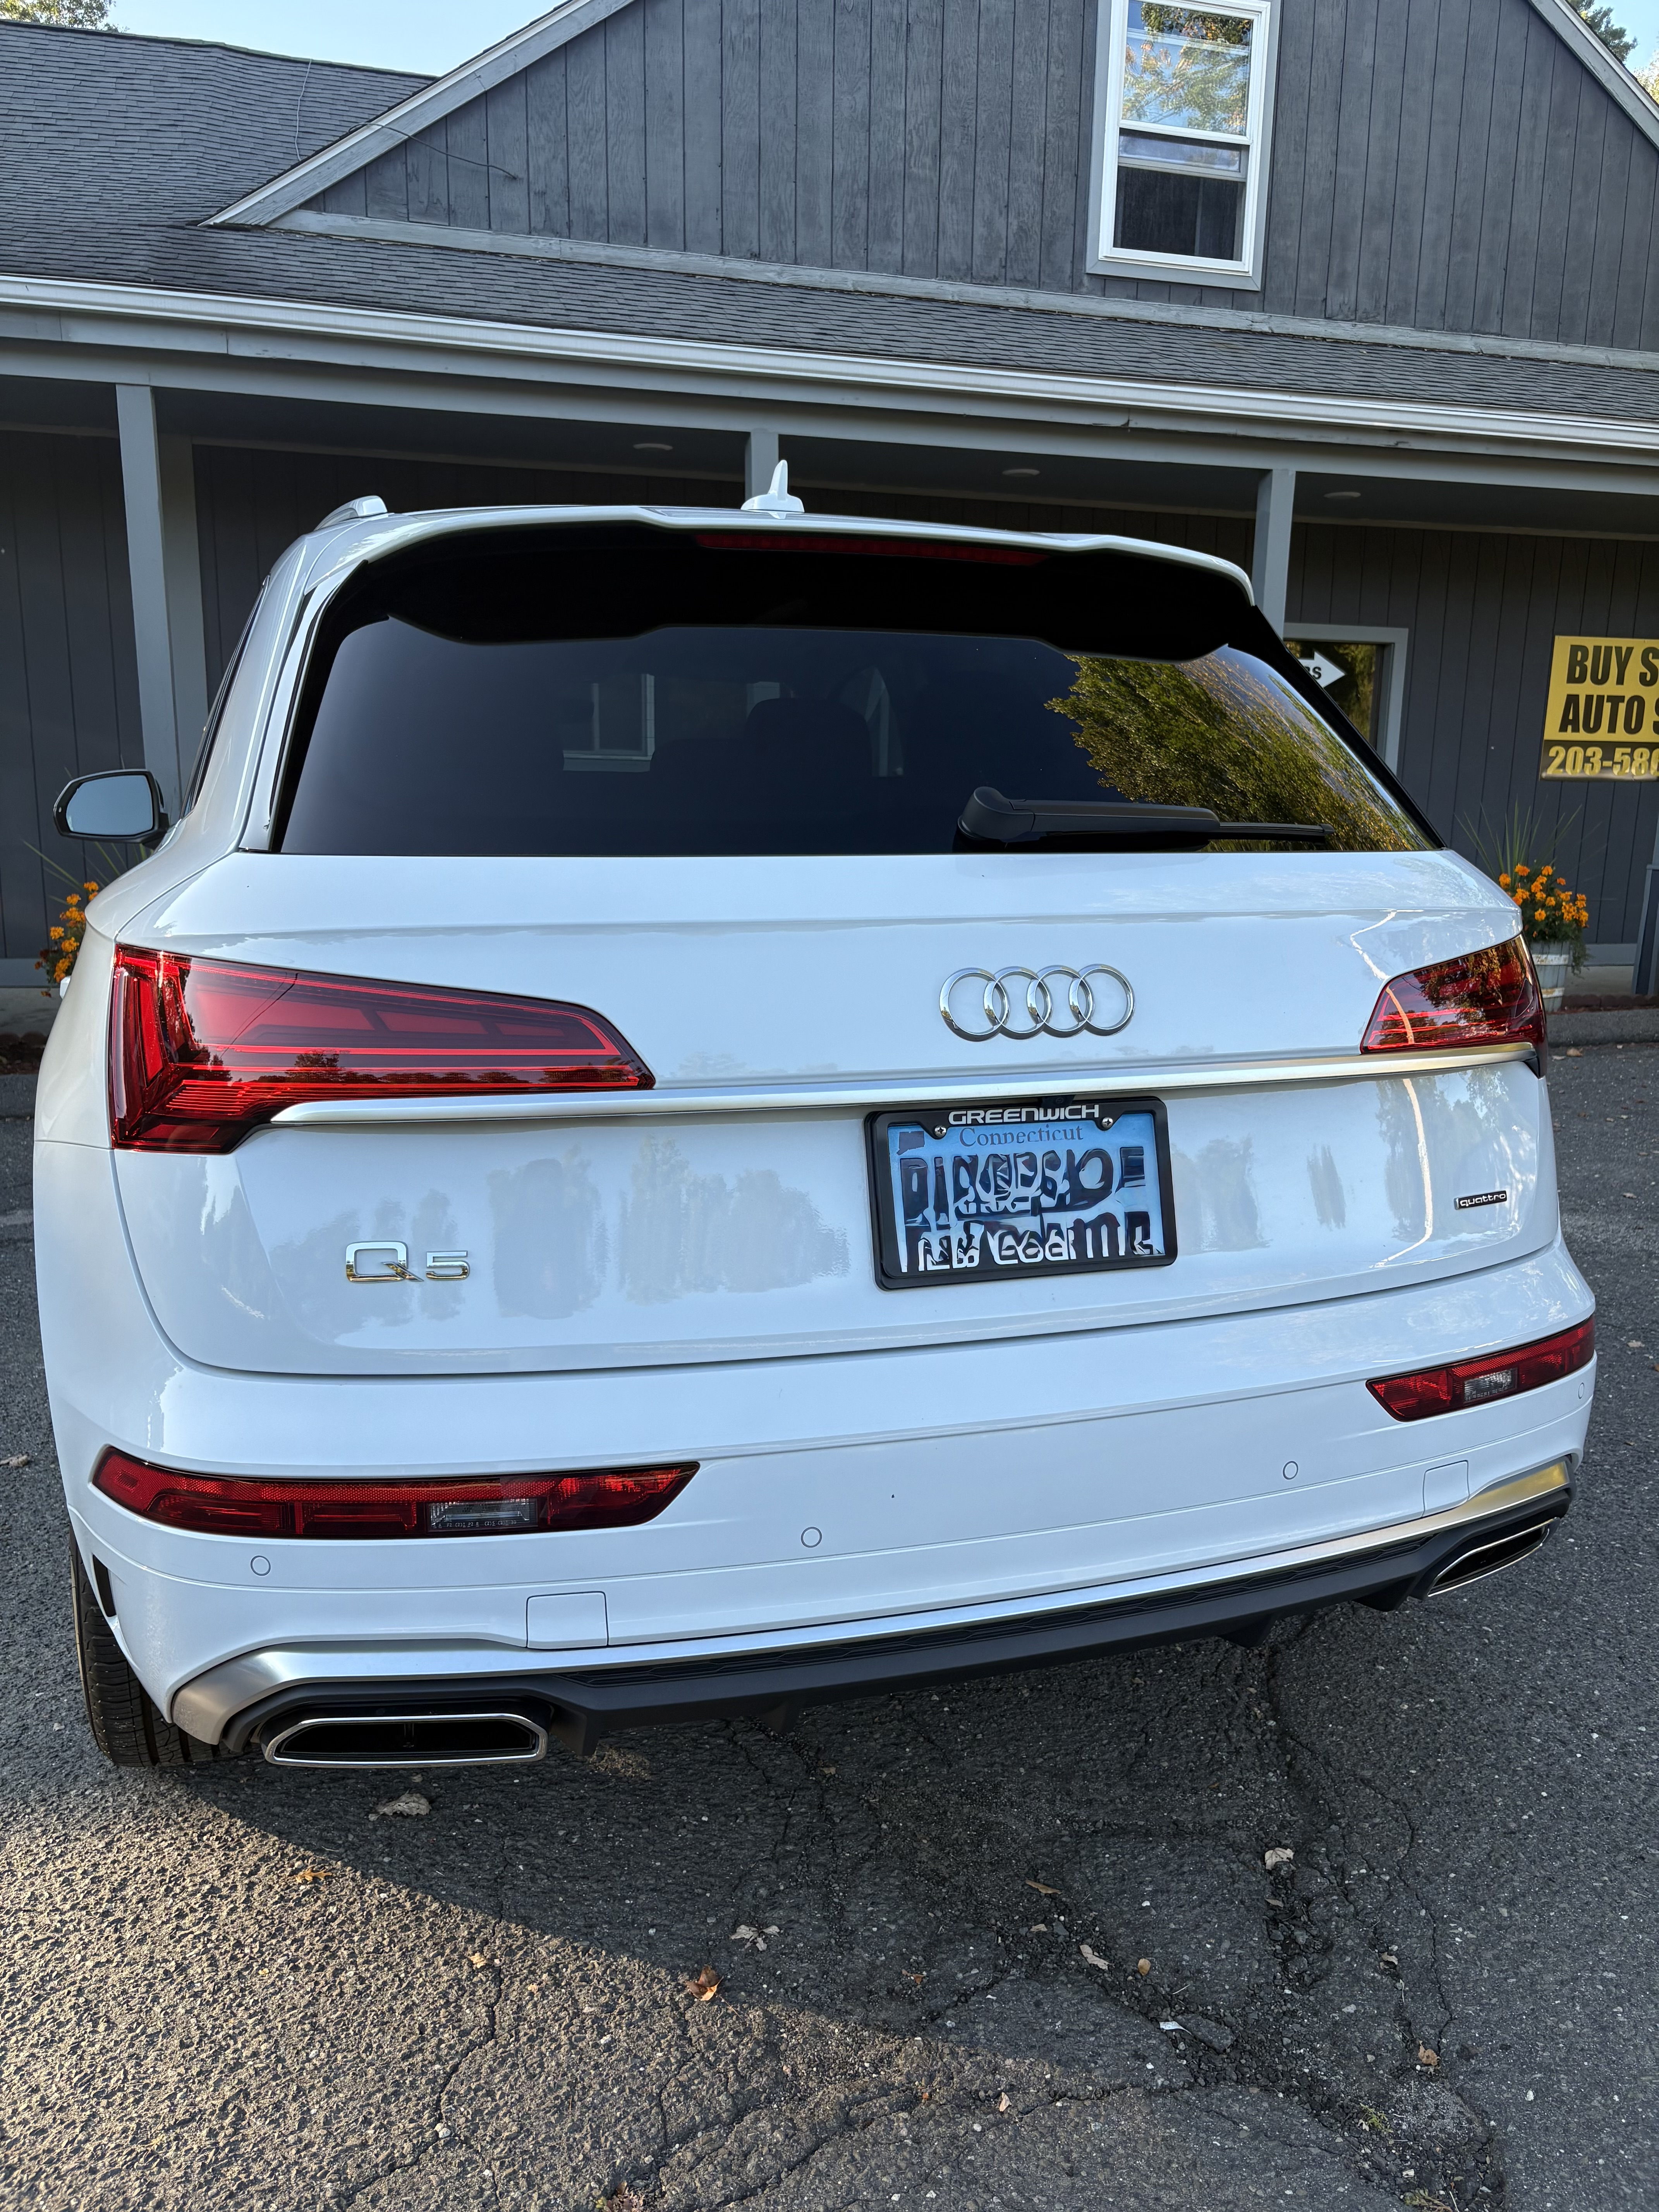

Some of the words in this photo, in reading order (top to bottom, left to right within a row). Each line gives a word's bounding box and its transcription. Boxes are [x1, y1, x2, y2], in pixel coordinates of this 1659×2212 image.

[1566, 645, 1634, 685] BUY
[1559, 694, 1645, 735] AUTO
[948, 1104, 1099, 1125] GREENWICH
[1460, 1193, 1506, 1206] quattro
[345, 1240, 470, 1283] Q5
